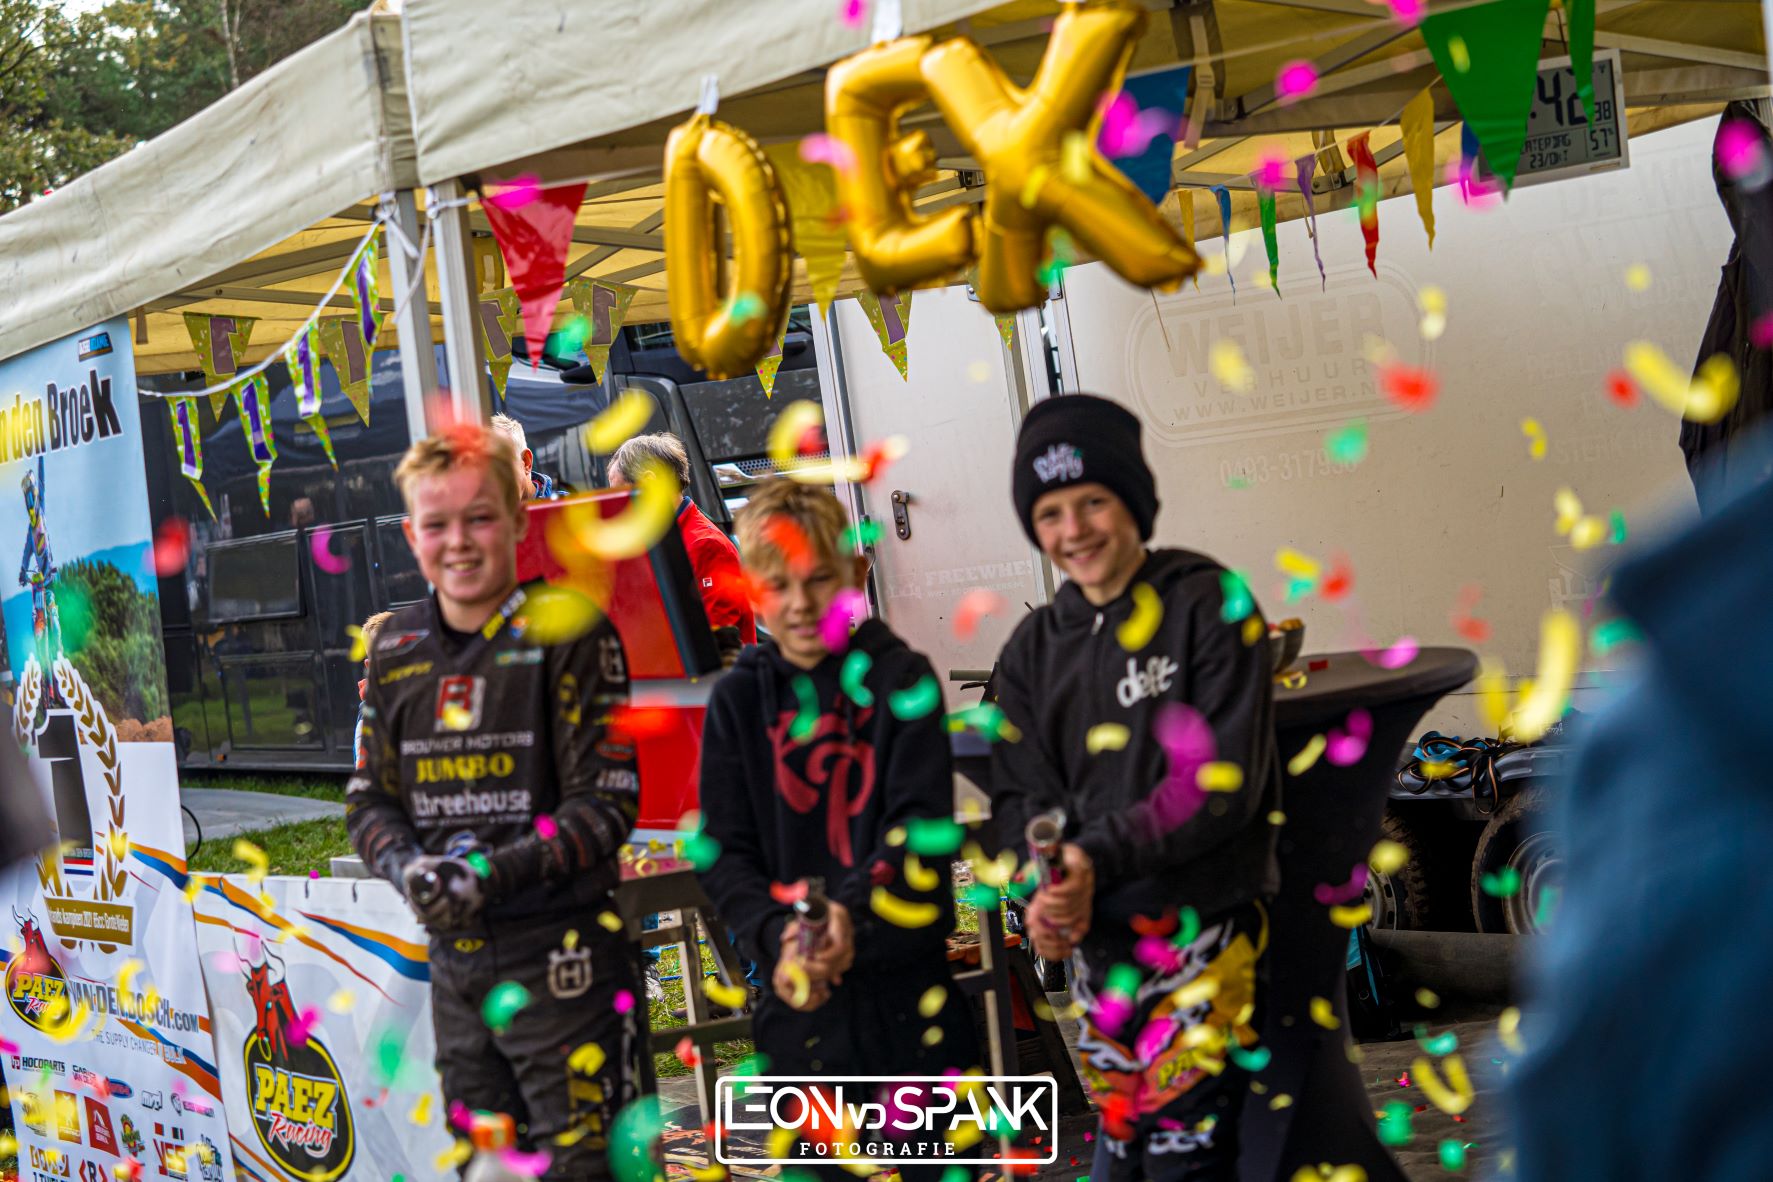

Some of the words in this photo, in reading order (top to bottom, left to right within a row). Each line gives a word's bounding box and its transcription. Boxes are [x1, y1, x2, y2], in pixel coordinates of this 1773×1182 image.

[1165, 292, 1385, 377] WEIJER
[1193, 358, 1369, 397] VEHUUR
[11, 393, 46, 460] den
[47, 368, 122, 451] Broek
[416, 752, 515, 784] JUMBO
[22, 1056, 65, 1072] HOCOPARTS
[255, 1064, 338, 1130] PAEZ
[267, 1112, 335, 1158] Racing
